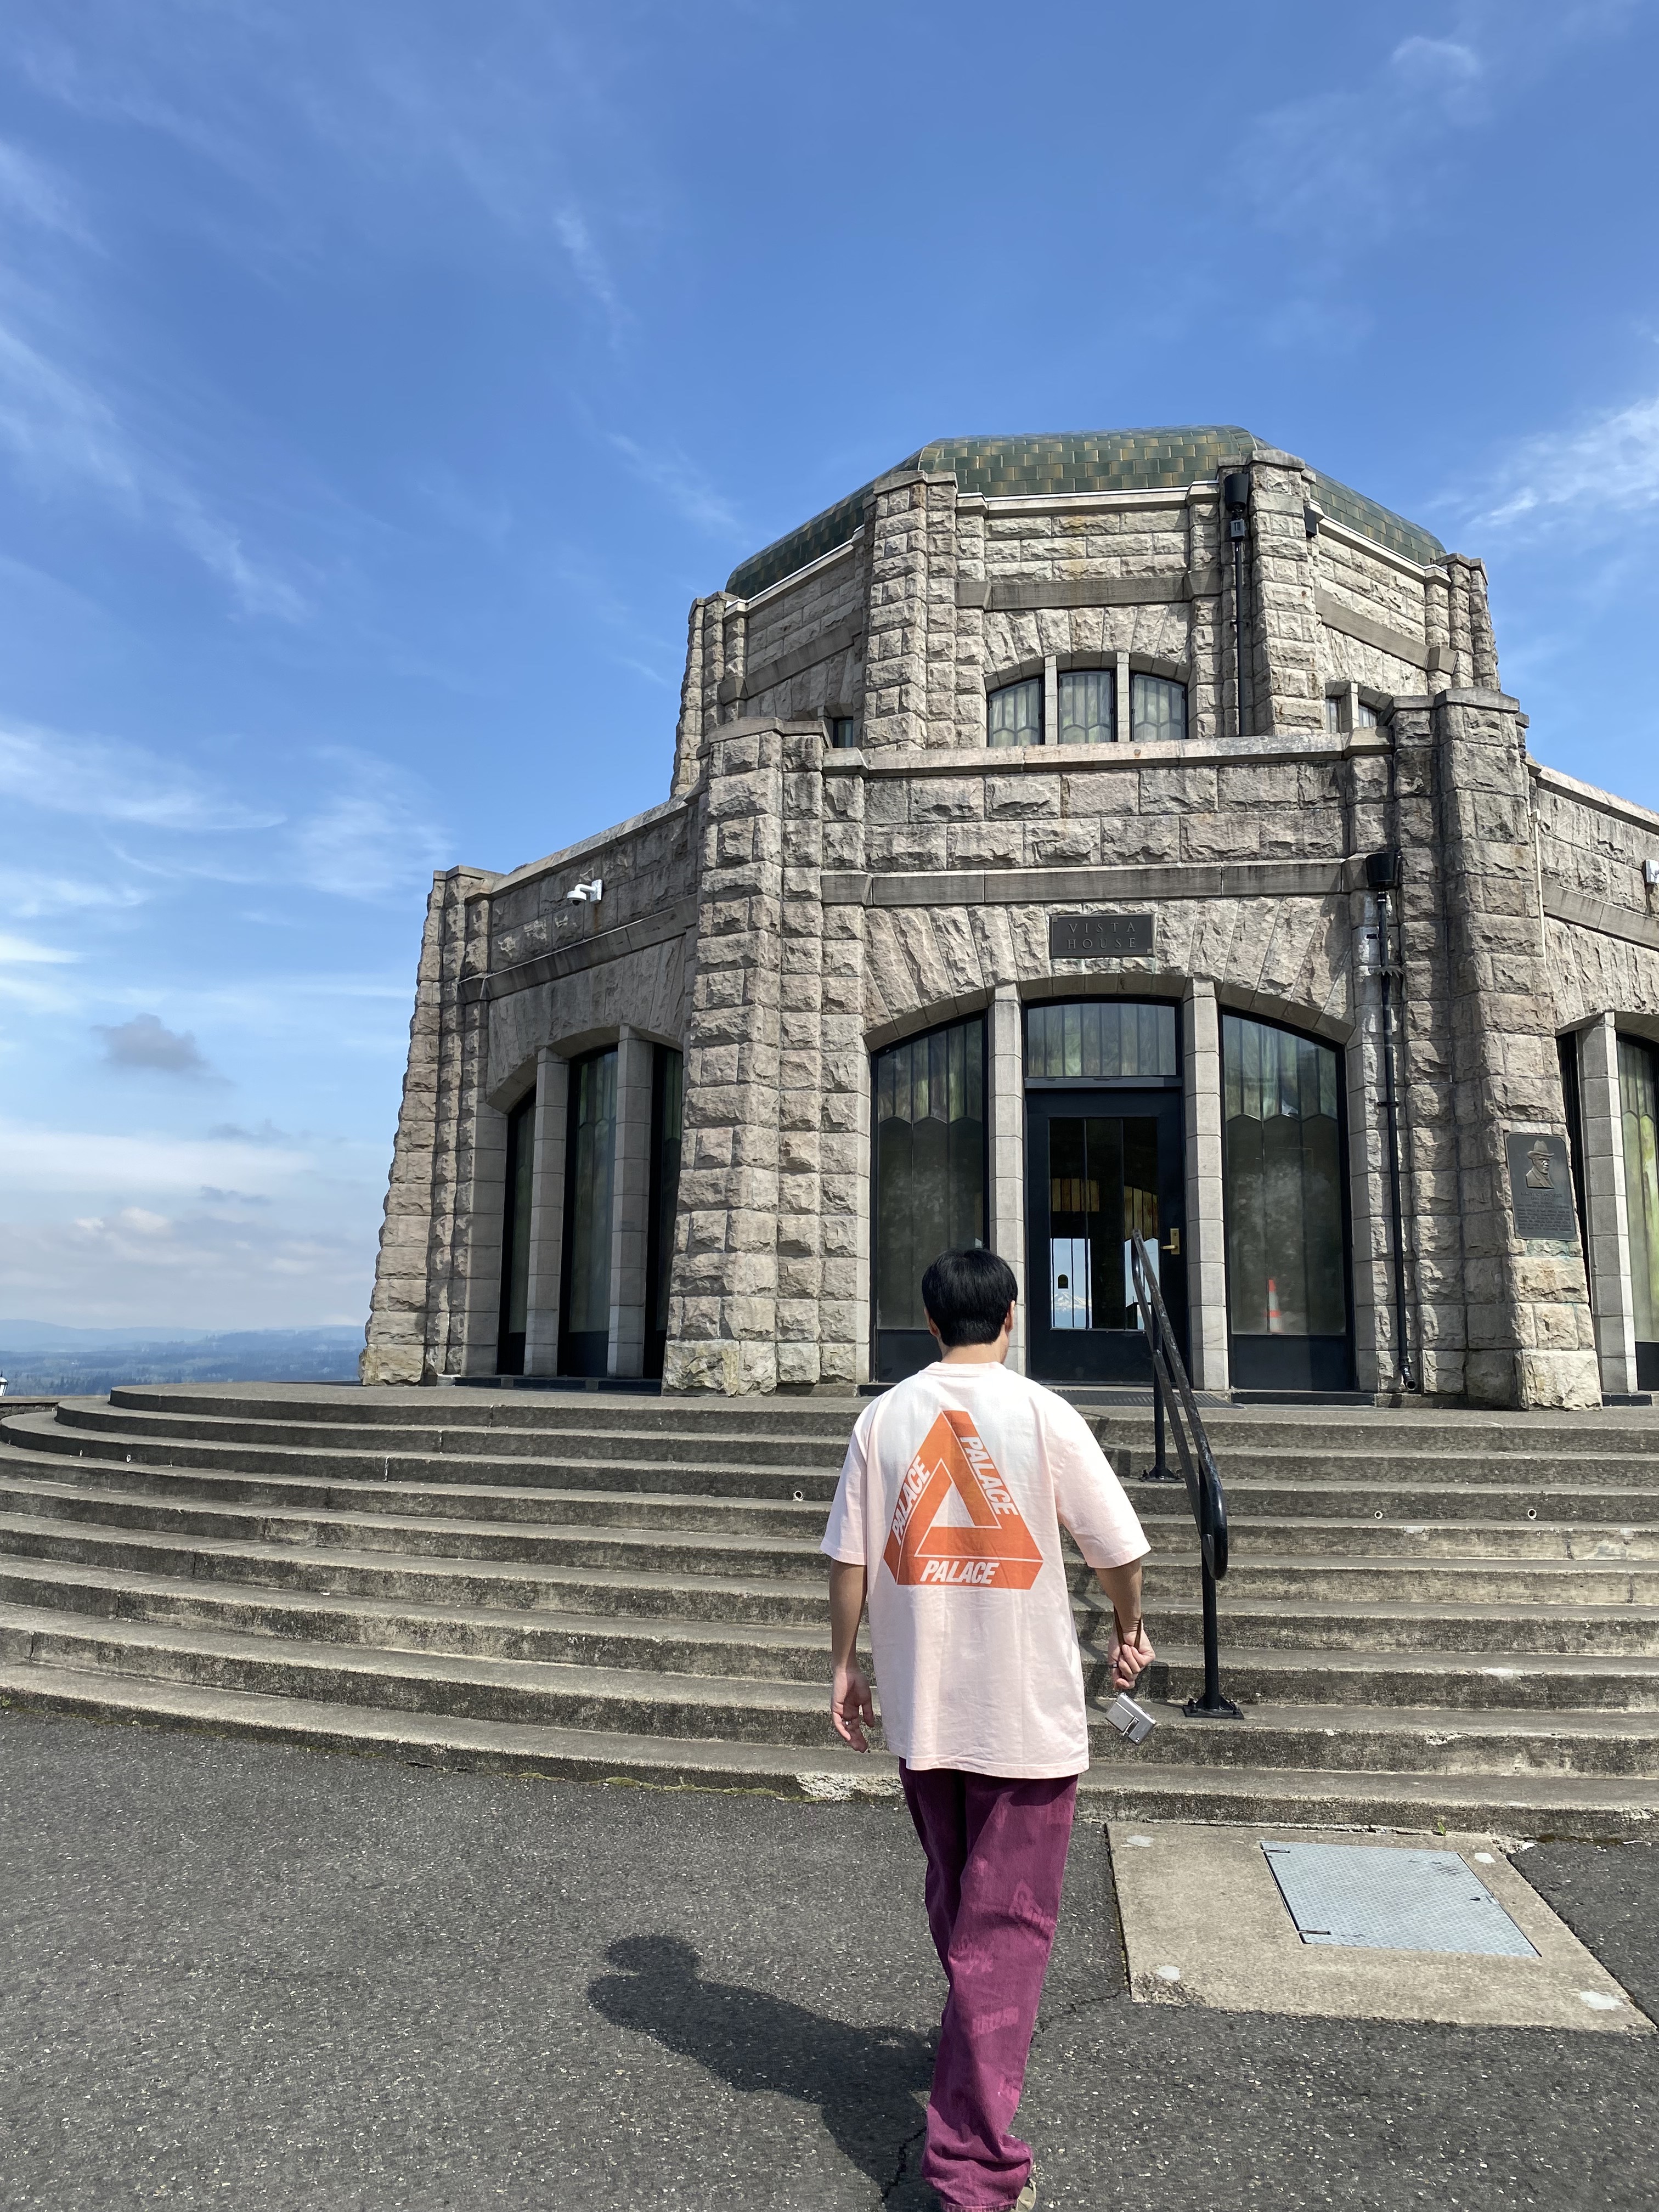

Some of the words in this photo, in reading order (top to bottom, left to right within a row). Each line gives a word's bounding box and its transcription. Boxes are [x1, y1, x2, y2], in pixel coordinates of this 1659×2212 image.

[1068, 922, 1136, 934] VISTA
[1067, 938, 1137, 950] HOUSE
[960, 1436, 1019, 1516] PALACE
[891, 1455, 930, 1546] PALACE
[919, 1560, 1000, 1585] PALACE
